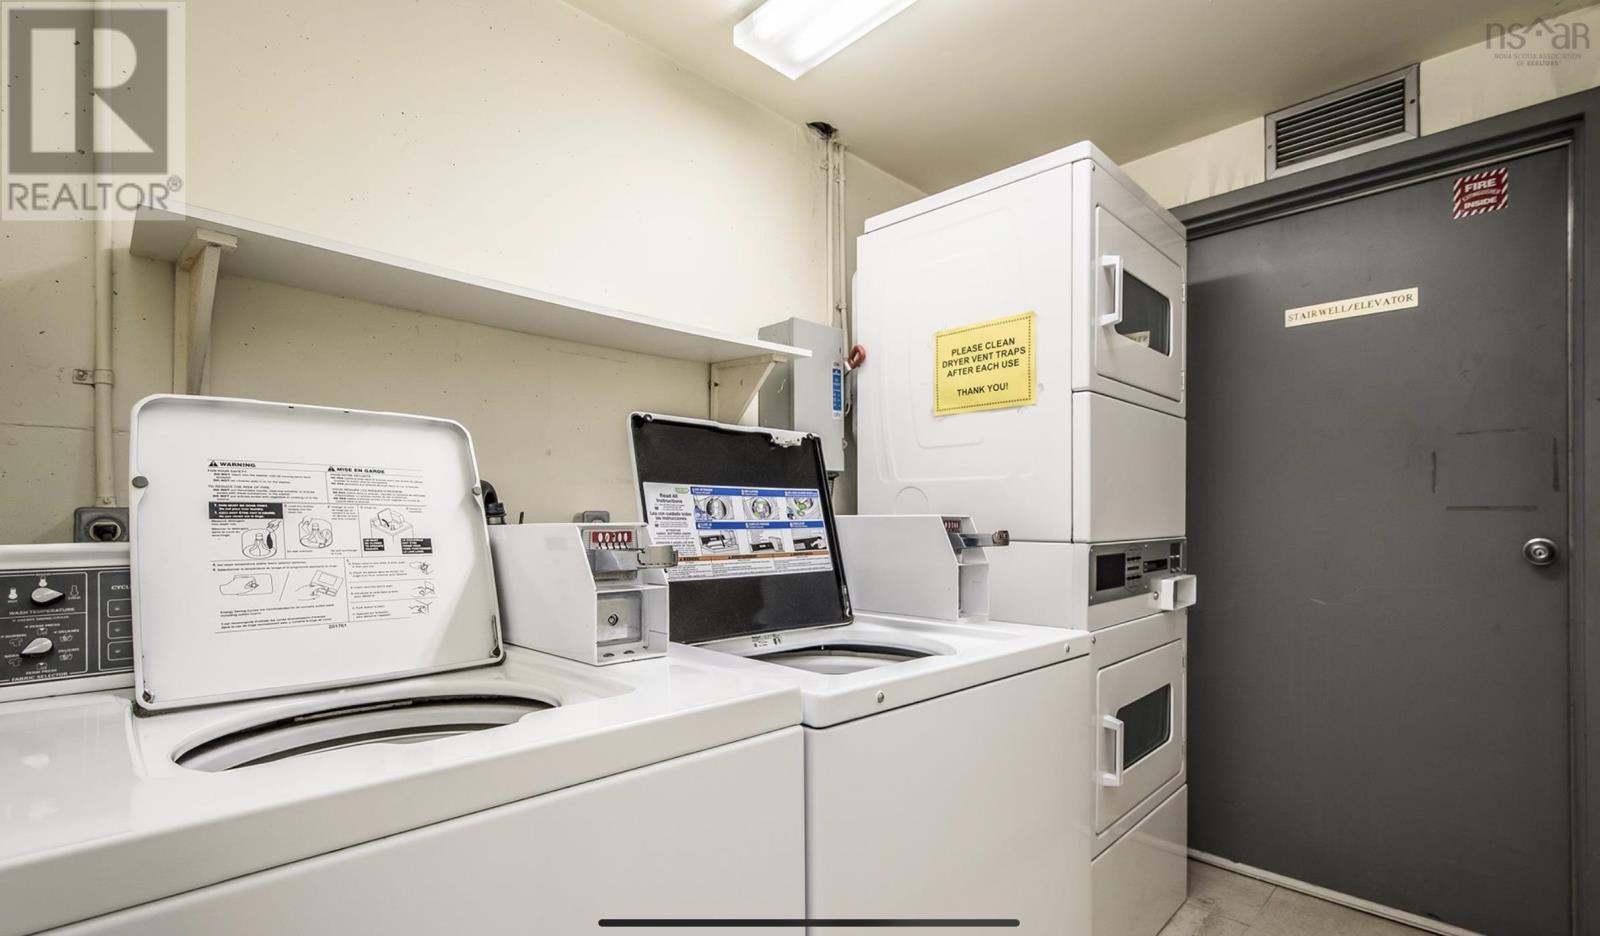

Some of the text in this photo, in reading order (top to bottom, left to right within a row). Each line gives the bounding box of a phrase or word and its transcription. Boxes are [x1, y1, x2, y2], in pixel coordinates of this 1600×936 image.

[1465, 178, 1497, 193] FIRE
[1463, 196, 1497, 209] INSIDE
[1287, 293, 1415, 322] STAIRWELL/ELEVATOR
[951, 337, 1015, 356] PLEASE CLEAN
[942, 346, 1026, 368] DRYER VENT TRAPS
[946, 358, 1019, 377] AFTER EACH USE
[957, 382, 1009, 396] THANK YOU!
